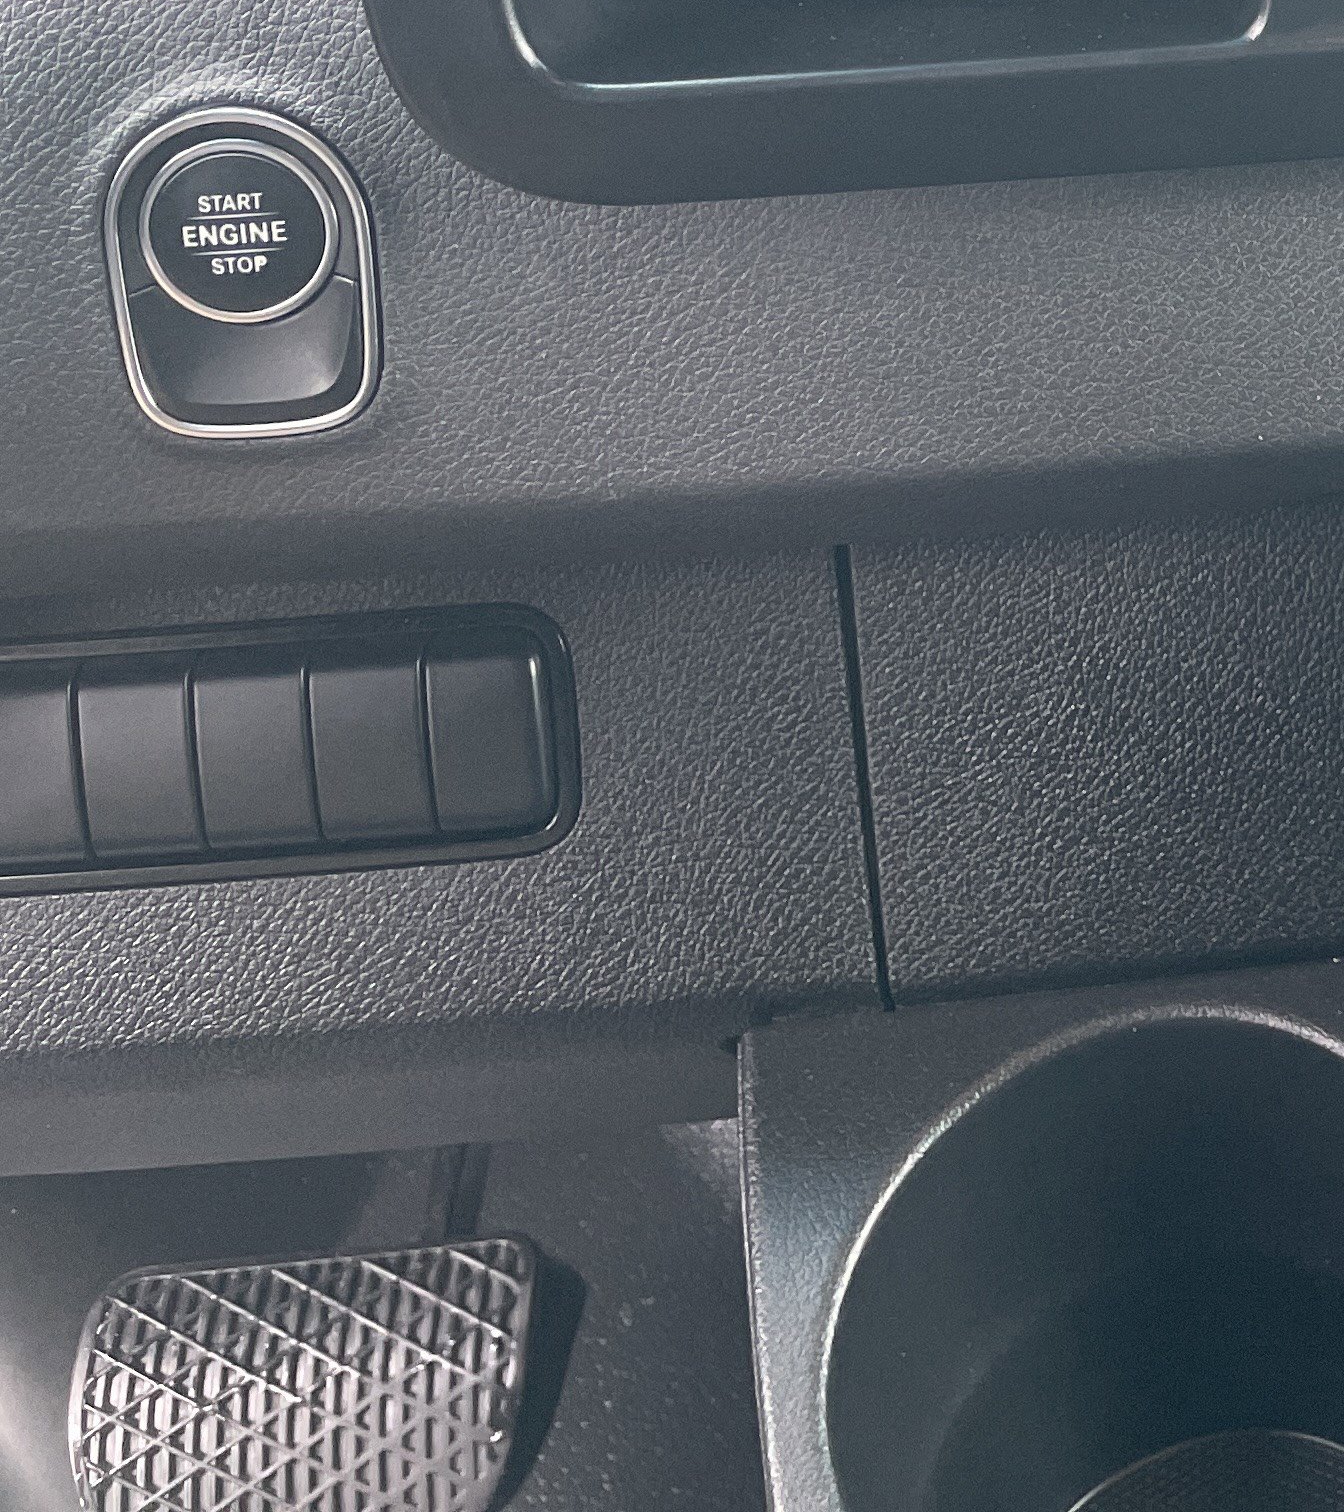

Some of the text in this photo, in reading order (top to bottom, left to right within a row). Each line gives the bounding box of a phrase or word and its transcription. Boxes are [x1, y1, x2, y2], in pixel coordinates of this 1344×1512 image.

[197, 192, 263, 214] START
[181, 220, 288, 248] ENGINE
[211, 255, 268, 275] STOP
